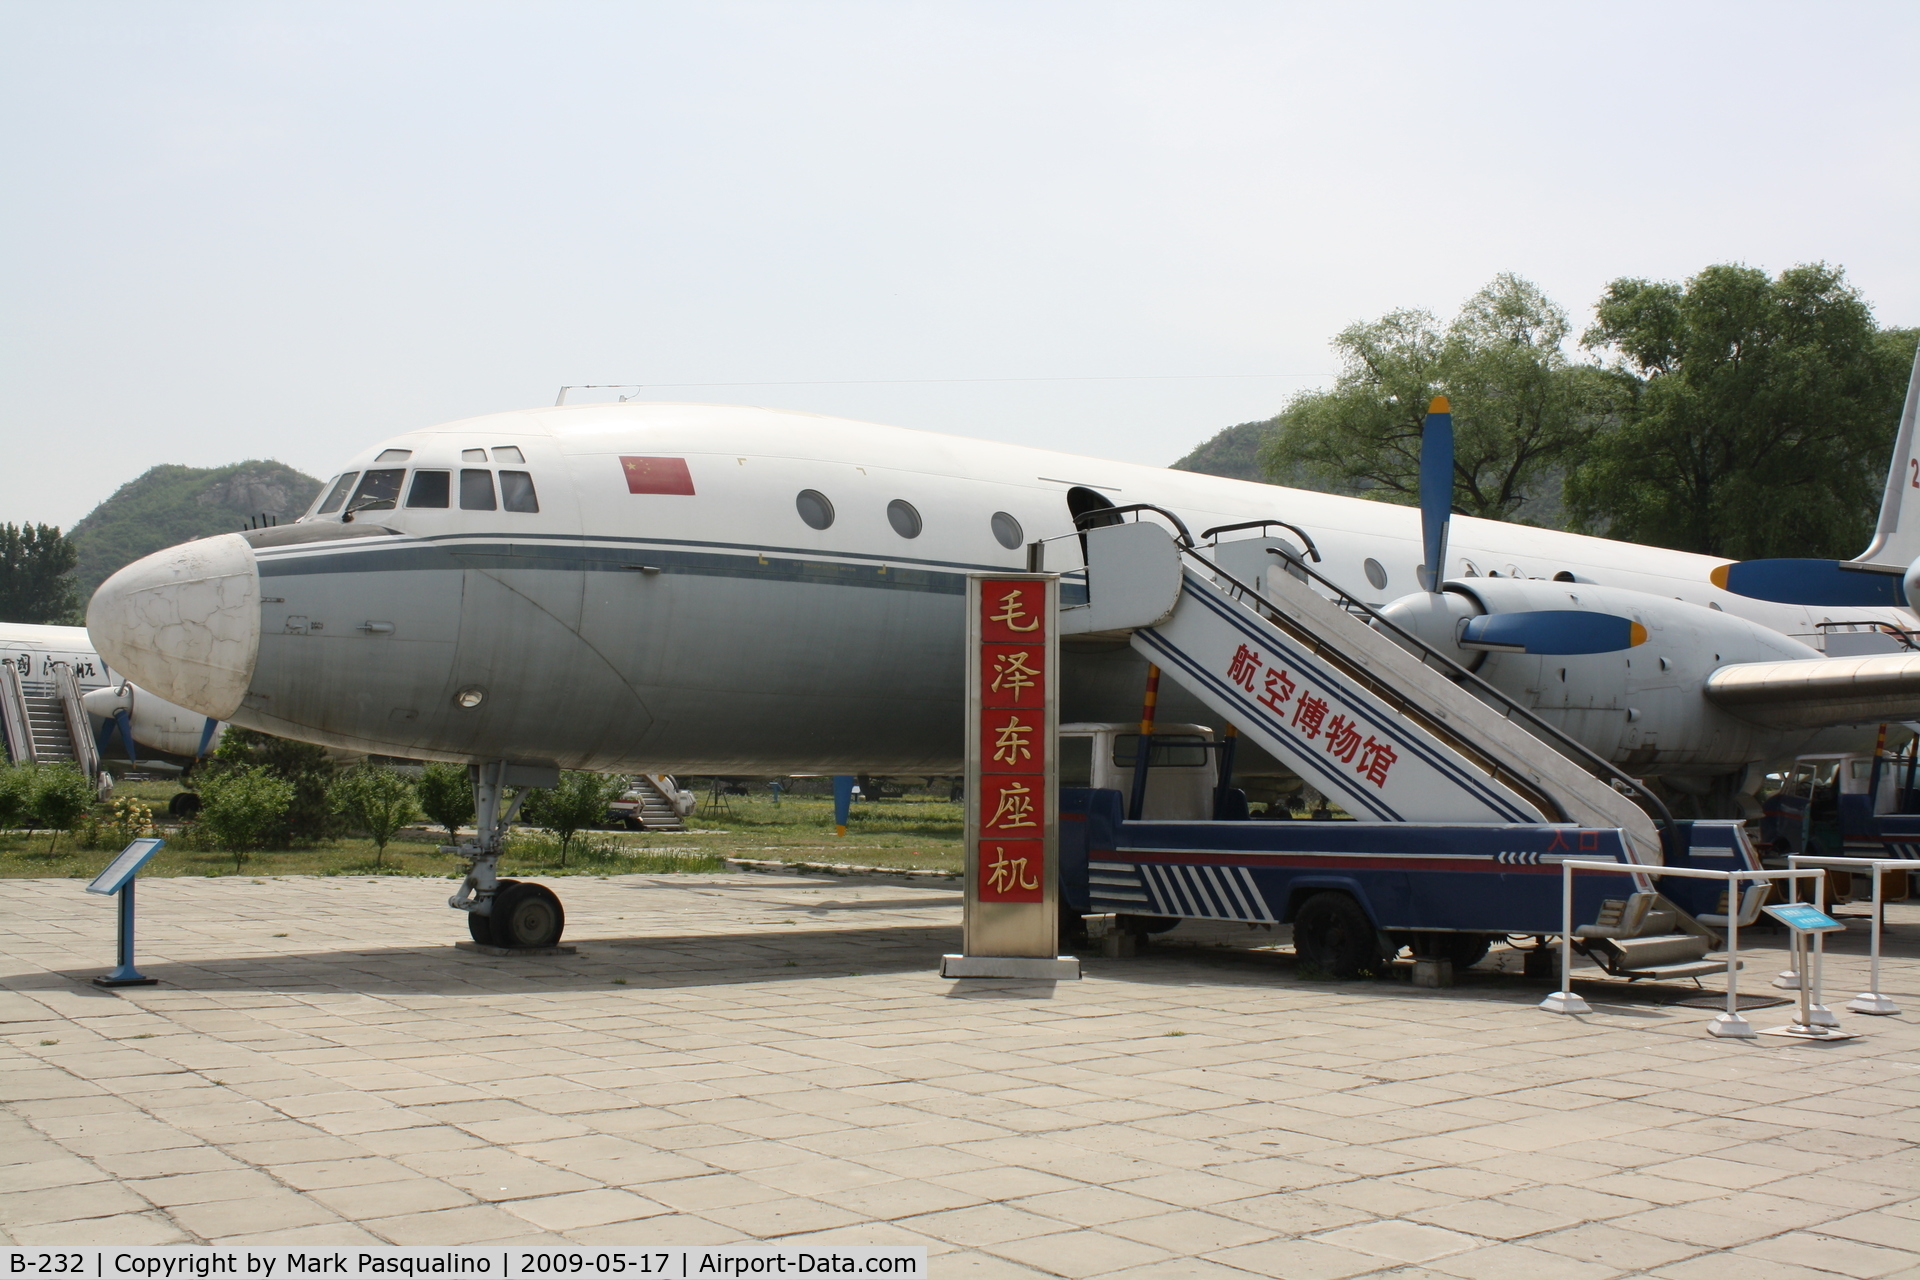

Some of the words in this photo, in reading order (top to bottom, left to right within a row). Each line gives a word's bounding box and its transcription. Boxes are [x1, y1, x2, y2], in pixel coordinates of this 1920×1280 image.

[985, 590, 1041, 894] 毛泽东座机
[1226, 643, 1398, 789] 航空博物馆
[1547, 829, 1599, 851] 入口
